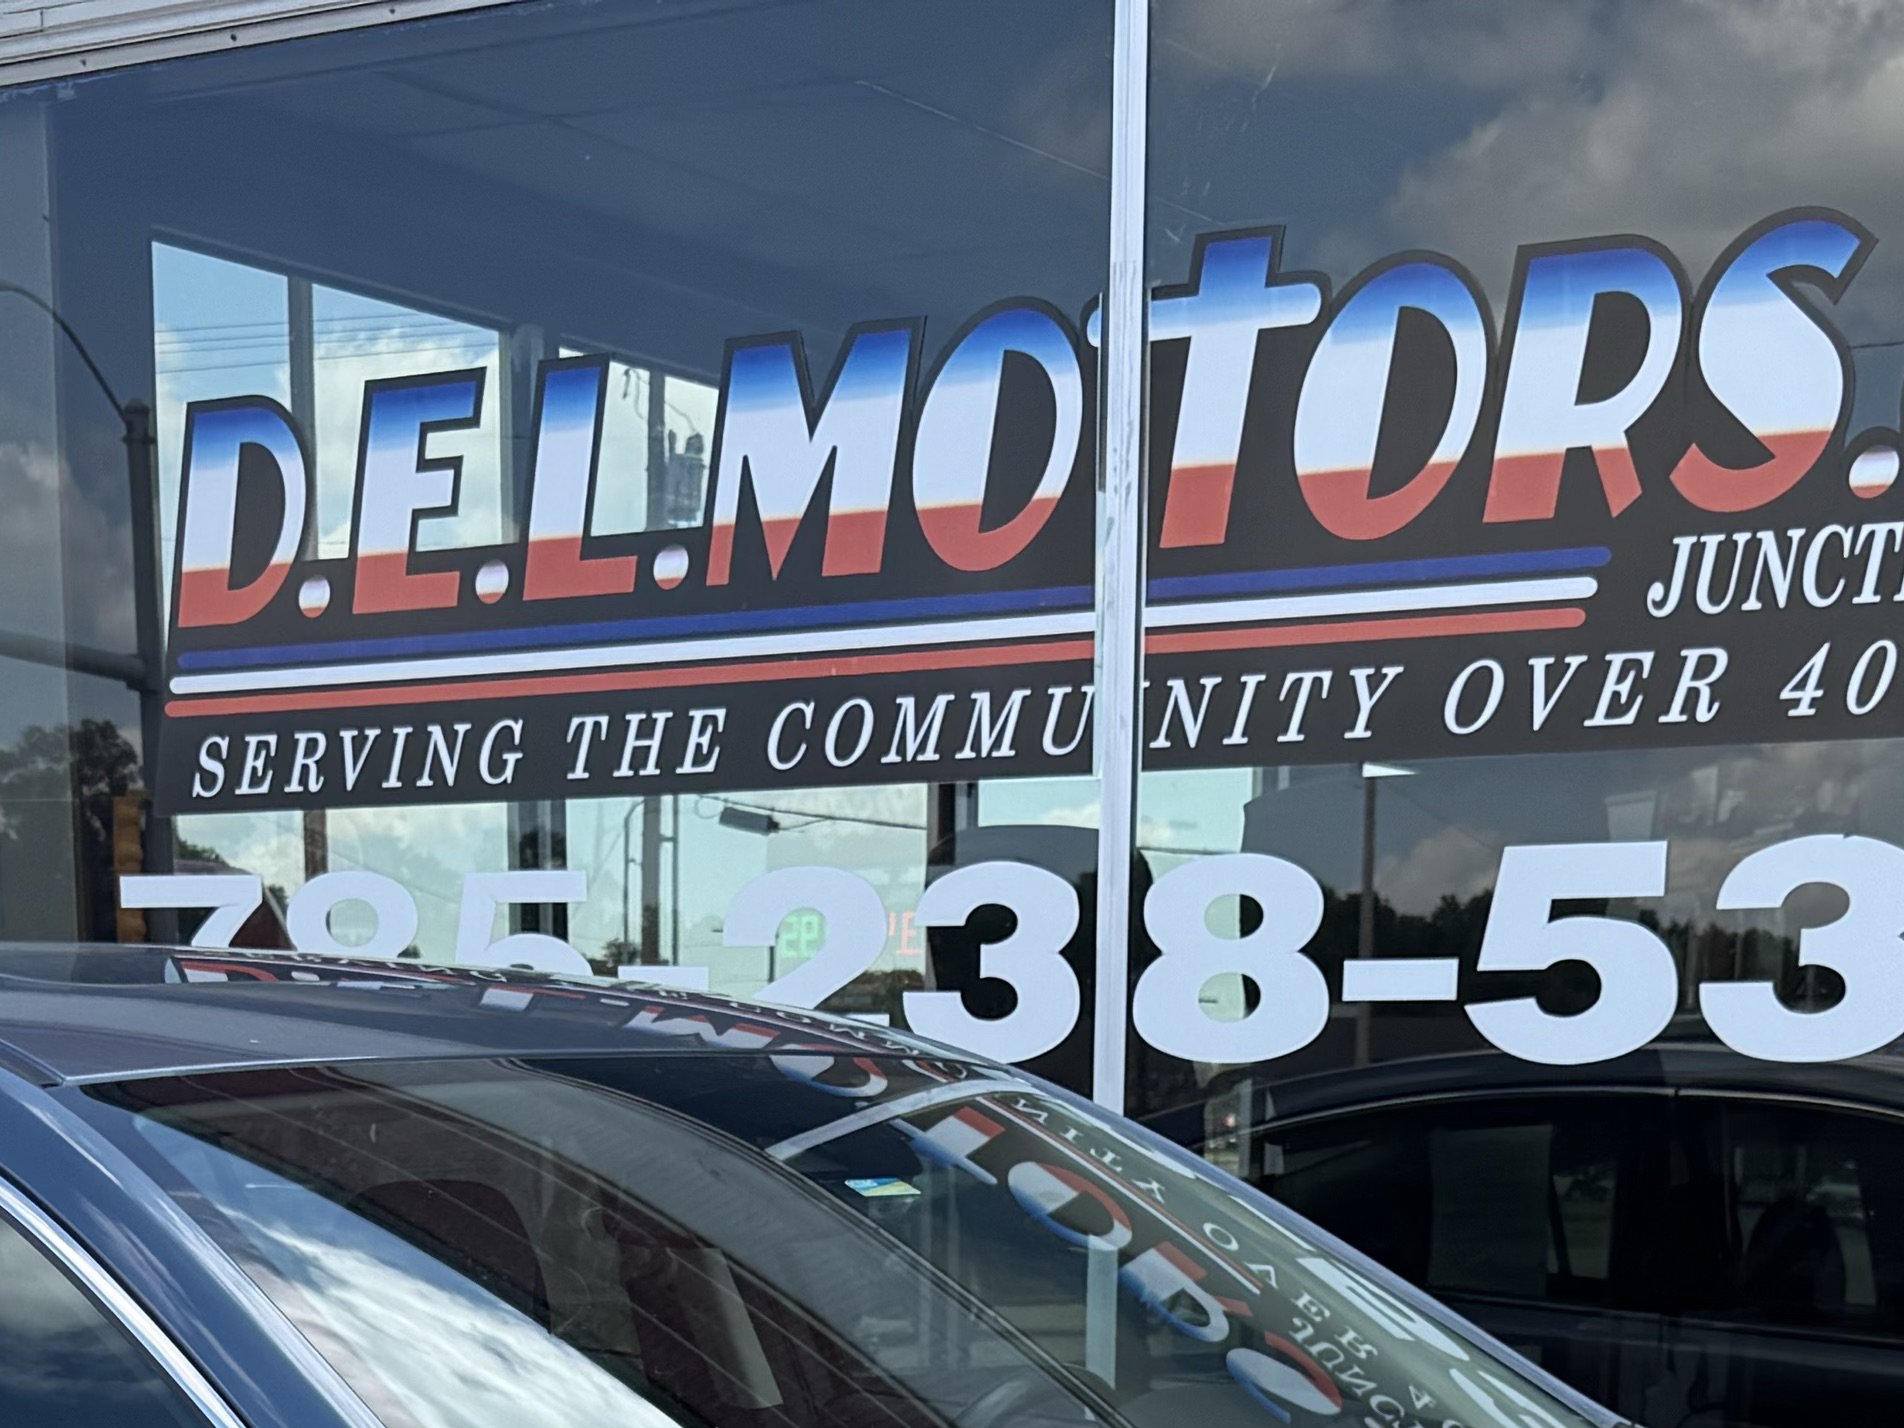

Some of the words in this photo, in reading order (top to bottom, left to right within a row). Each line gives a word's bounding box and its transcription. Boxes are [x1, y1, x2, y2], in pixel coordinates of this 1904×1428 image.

[191, 718, 524, 799] SERVING
[565, 707, 728, 781] THE
[766, 665, 1405, 771] COMMUNITY
[1443, 646, 1730, 736] OVER
[1778, 638, 1898, 718] 40
